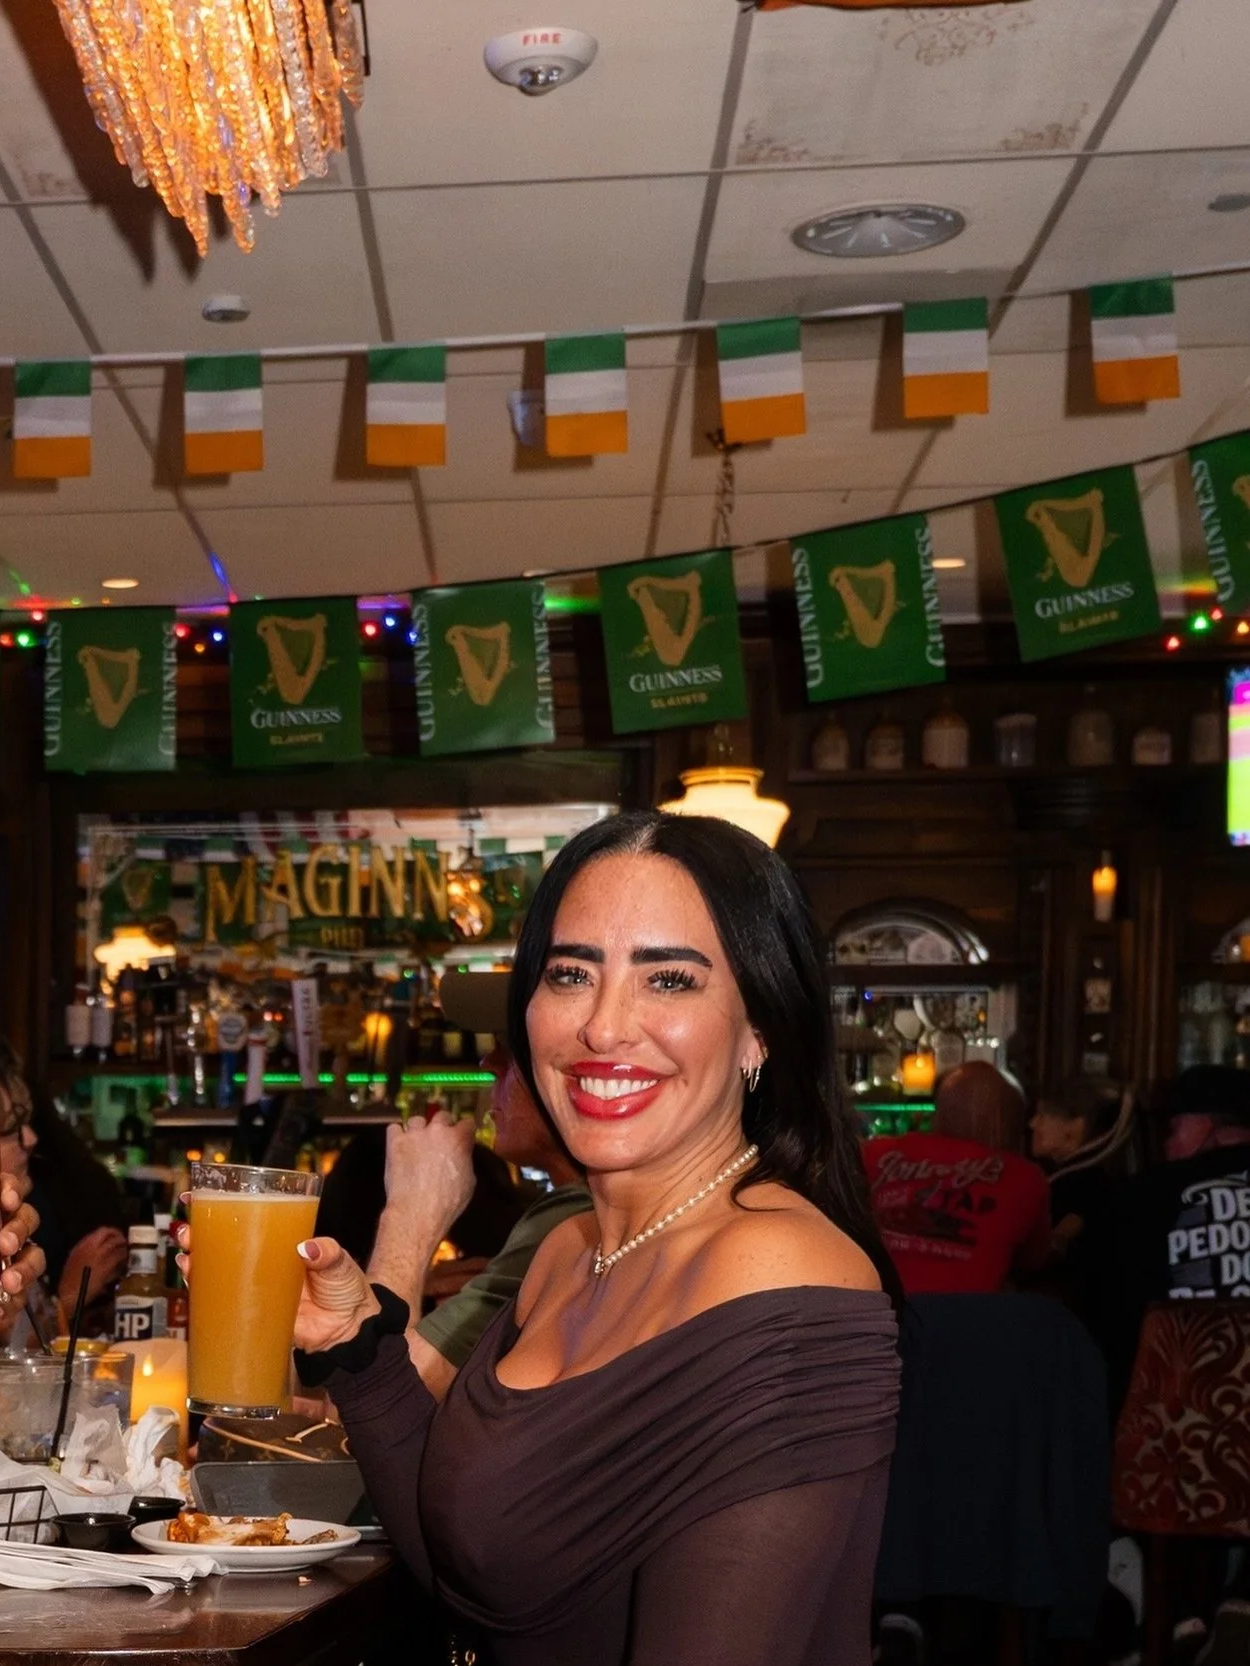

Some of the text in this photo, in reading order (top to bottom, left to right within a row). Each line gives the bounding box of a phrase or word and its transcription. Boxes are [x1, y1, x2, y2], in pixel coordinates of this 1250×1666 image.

[521, 33, 562, 46] FIRE
[1192, 460, 1235, 601] GUINNESS
[792, 547, 824, 689] GUINNESS
[1034, 582, 1135, 619] GUINNESS
[43, 621, 63, 757] GUINNESS
[413, 603, 437, 742] GUINNESS
[629, 664, 723, 693] GUINNESS
[250, 706, 343, 729] GUINNESS
[114, 1312, 150, 1338] HP
